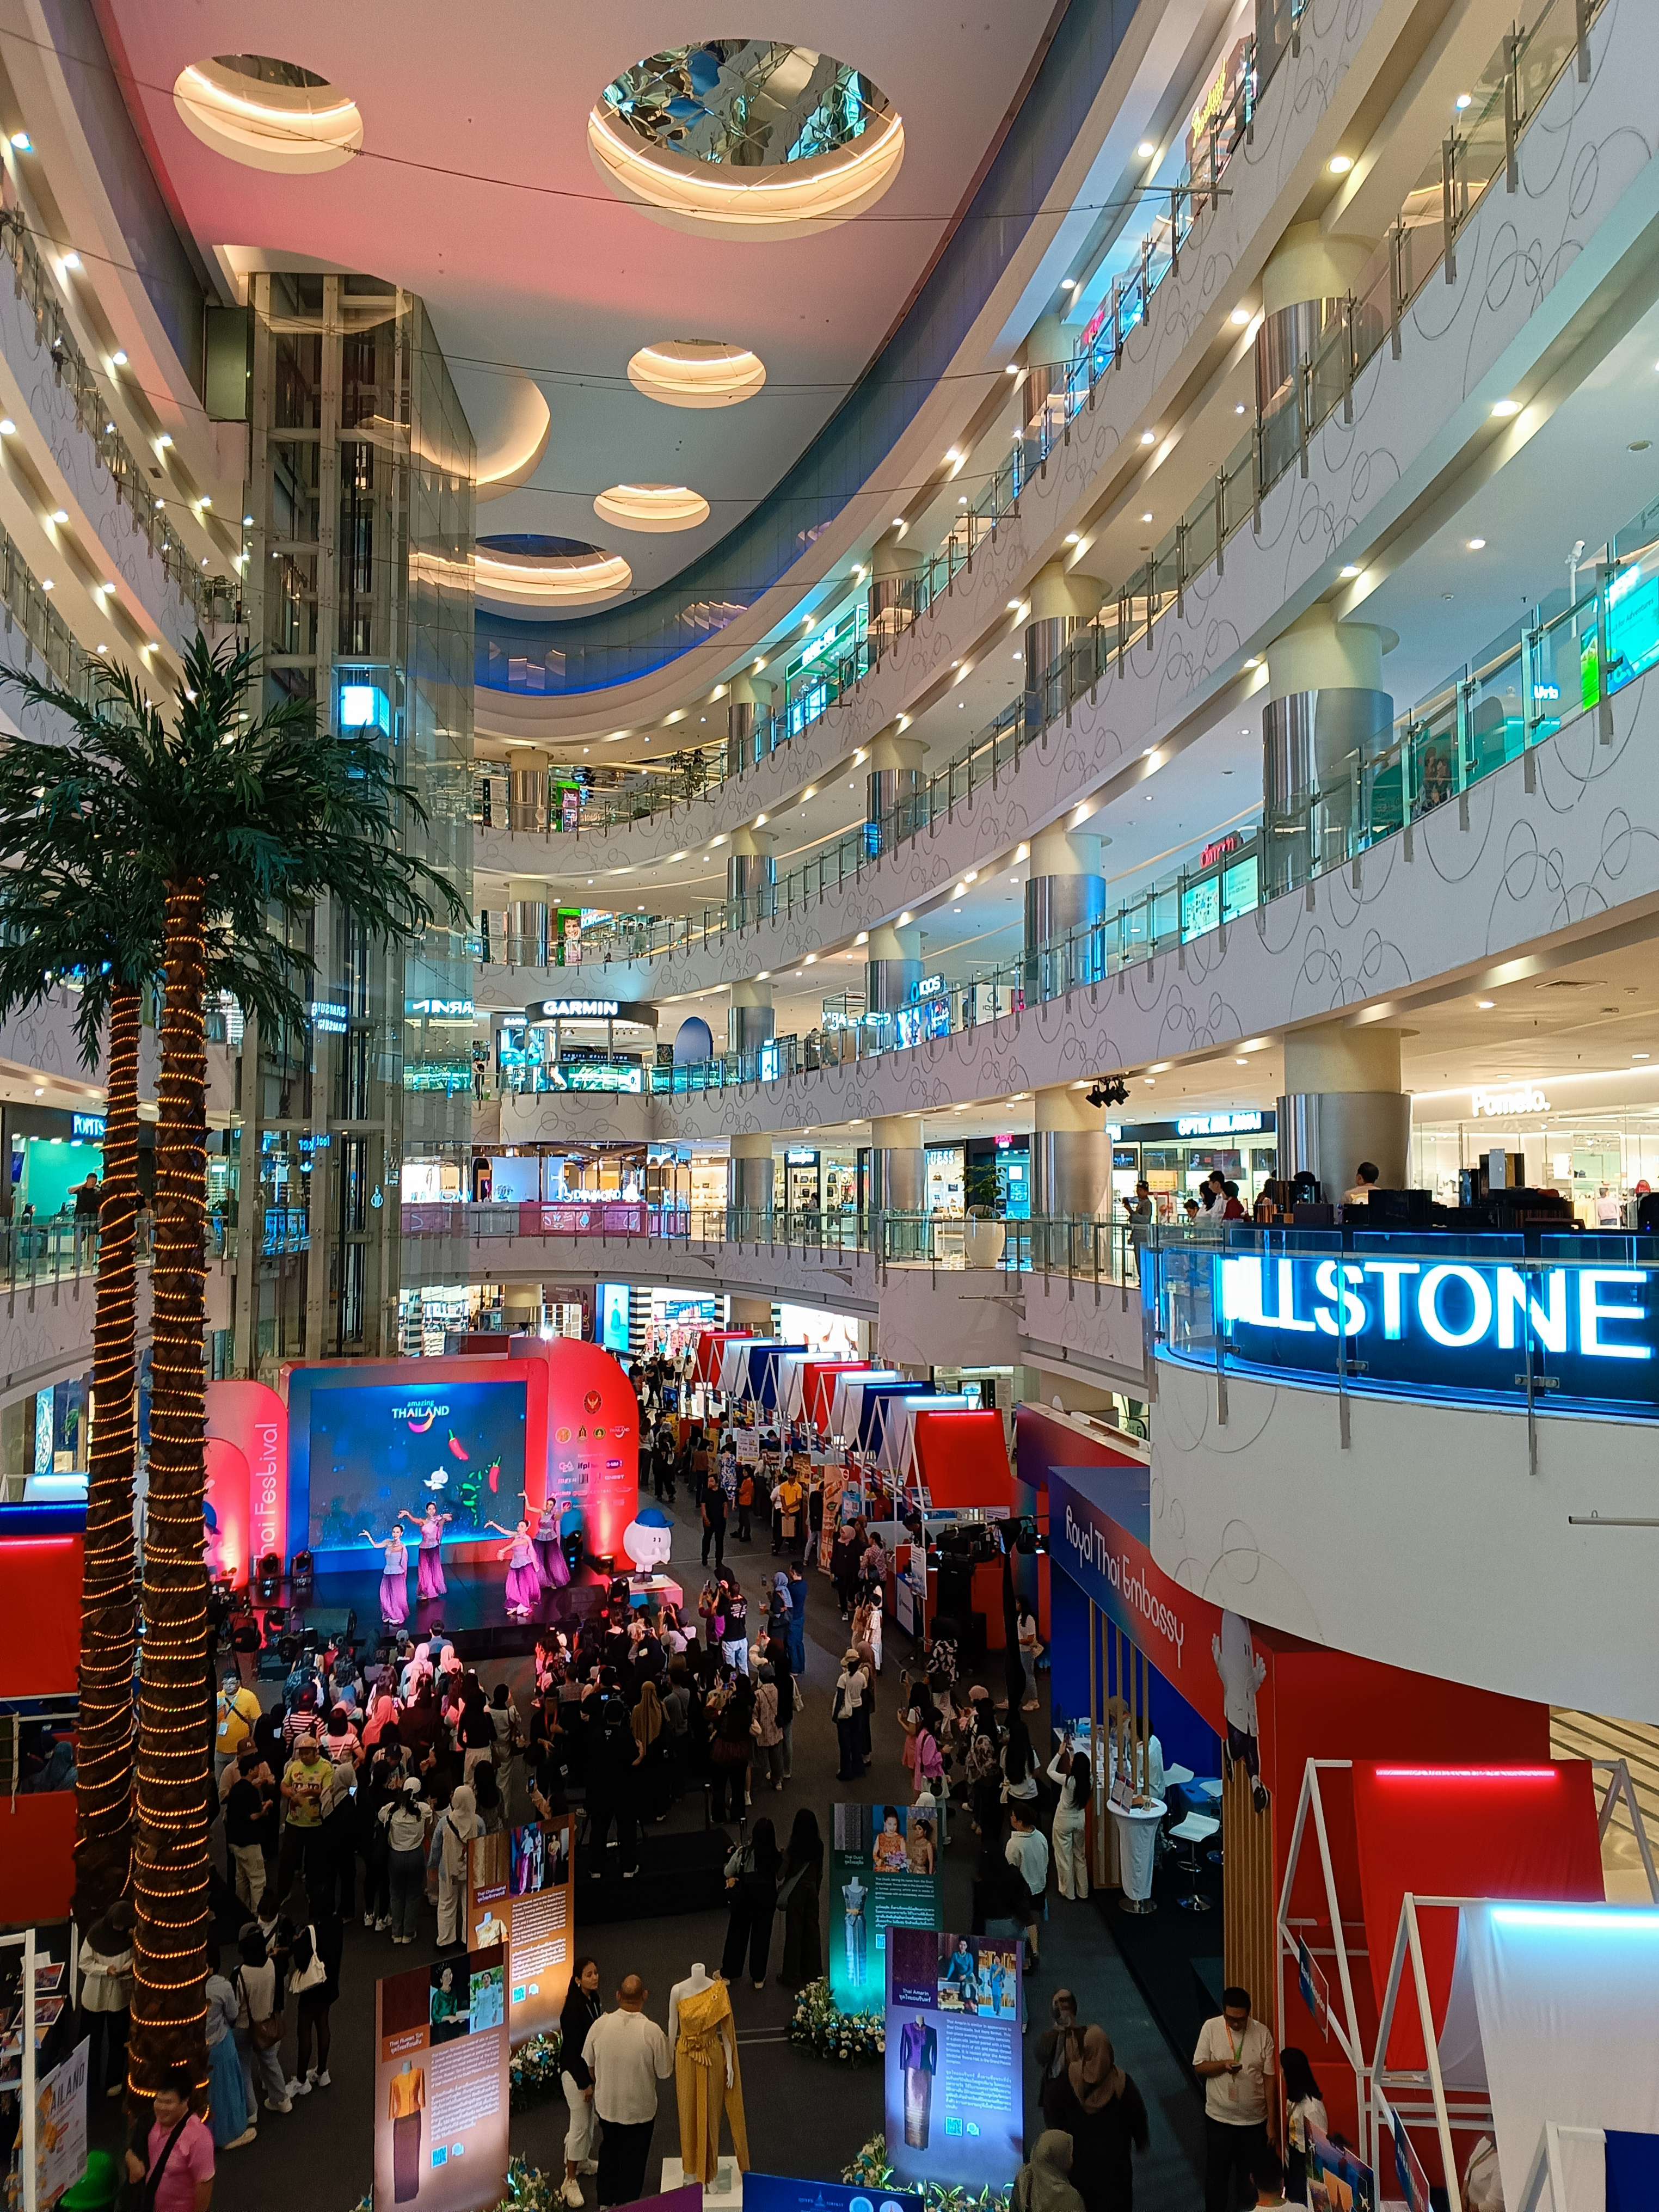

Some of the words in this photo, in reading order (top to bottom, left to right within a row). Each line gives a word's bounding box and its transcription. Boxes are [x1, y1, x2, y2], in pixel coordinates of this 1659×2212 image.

[919, 975, 941, 996] IQOS
[543, 1000, 618, 1015] GARMIN
[391, 1405, 450, 1419] THAILAND
[254, 1423, 278, 1515] Festival
[1065, 1504, 1093, 1569] Royal
[1095, 1529, 1120, 1590] Thai
[1122, 1554, 1184, 1669] Embassy
